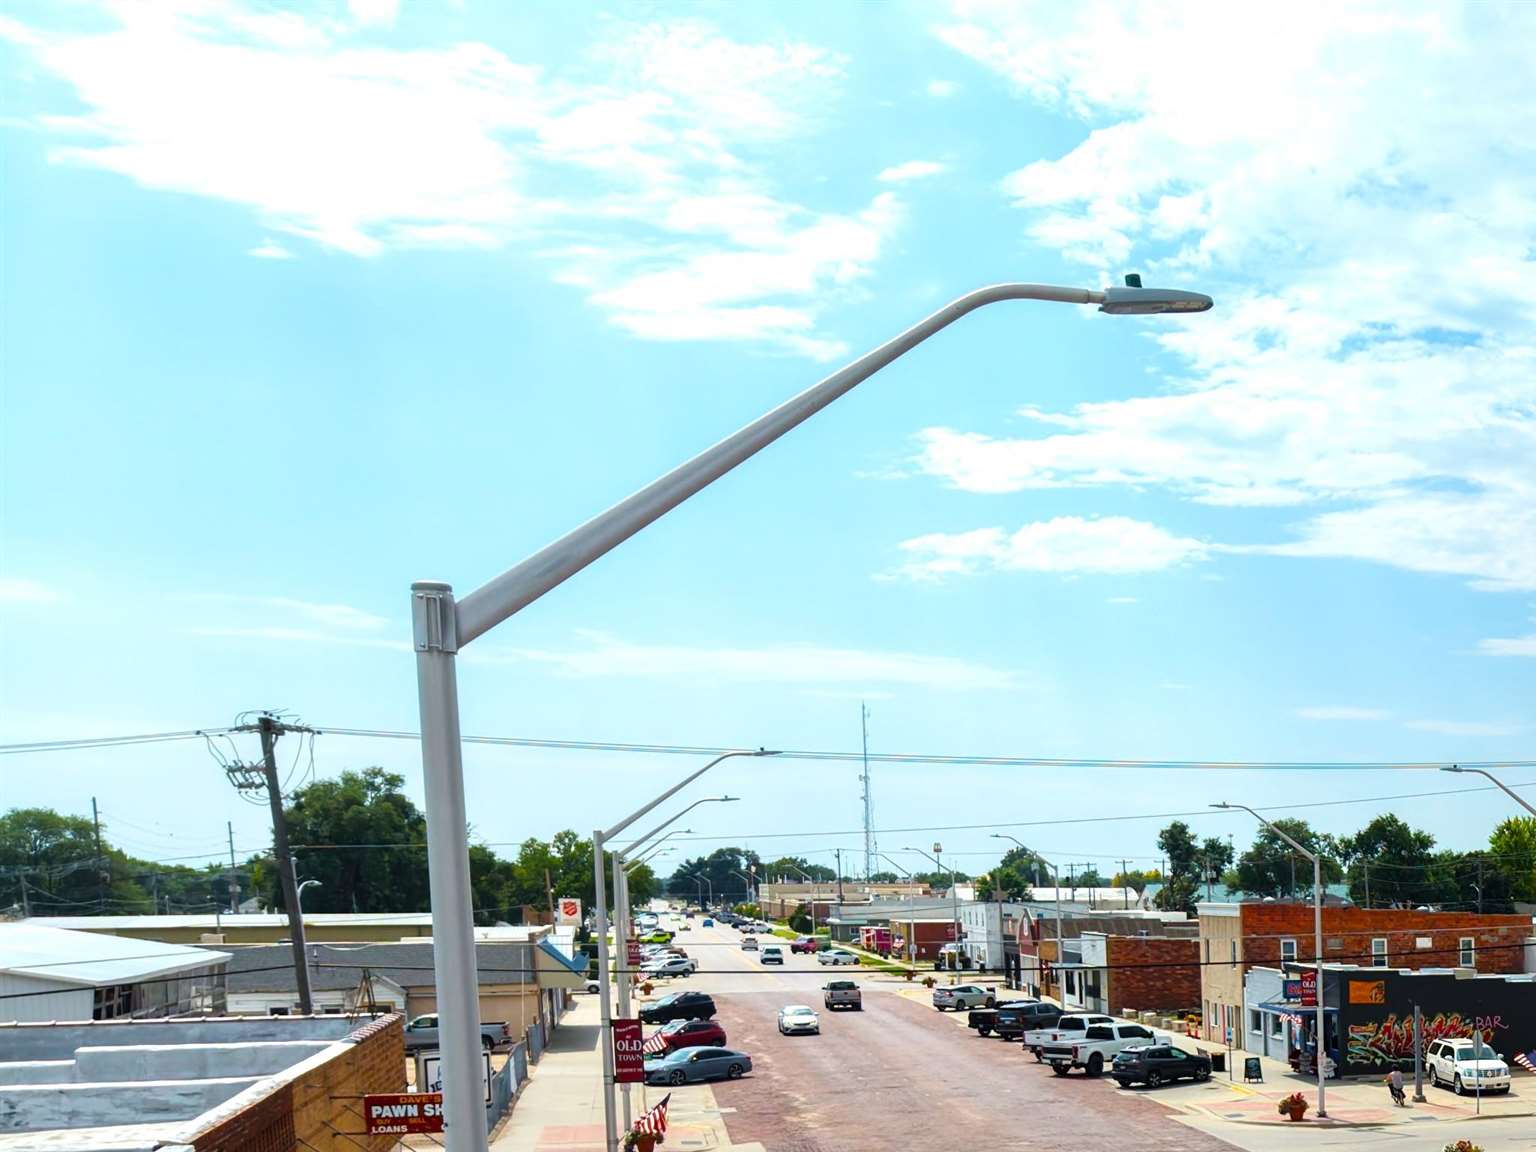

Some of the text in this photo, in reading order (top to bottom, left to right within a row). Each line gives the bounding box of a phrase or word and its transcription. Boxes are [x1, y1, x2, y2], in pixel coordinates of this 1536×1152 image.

[1476, 1015, 1509, 1030] BAR
[616, 1040, 642, 1051] OLD
[618, 1054, 643, 1062] TOWN
[371, 1104, 419, 1118] PAWN
[371, 1124, 409, 1134] LOANS
